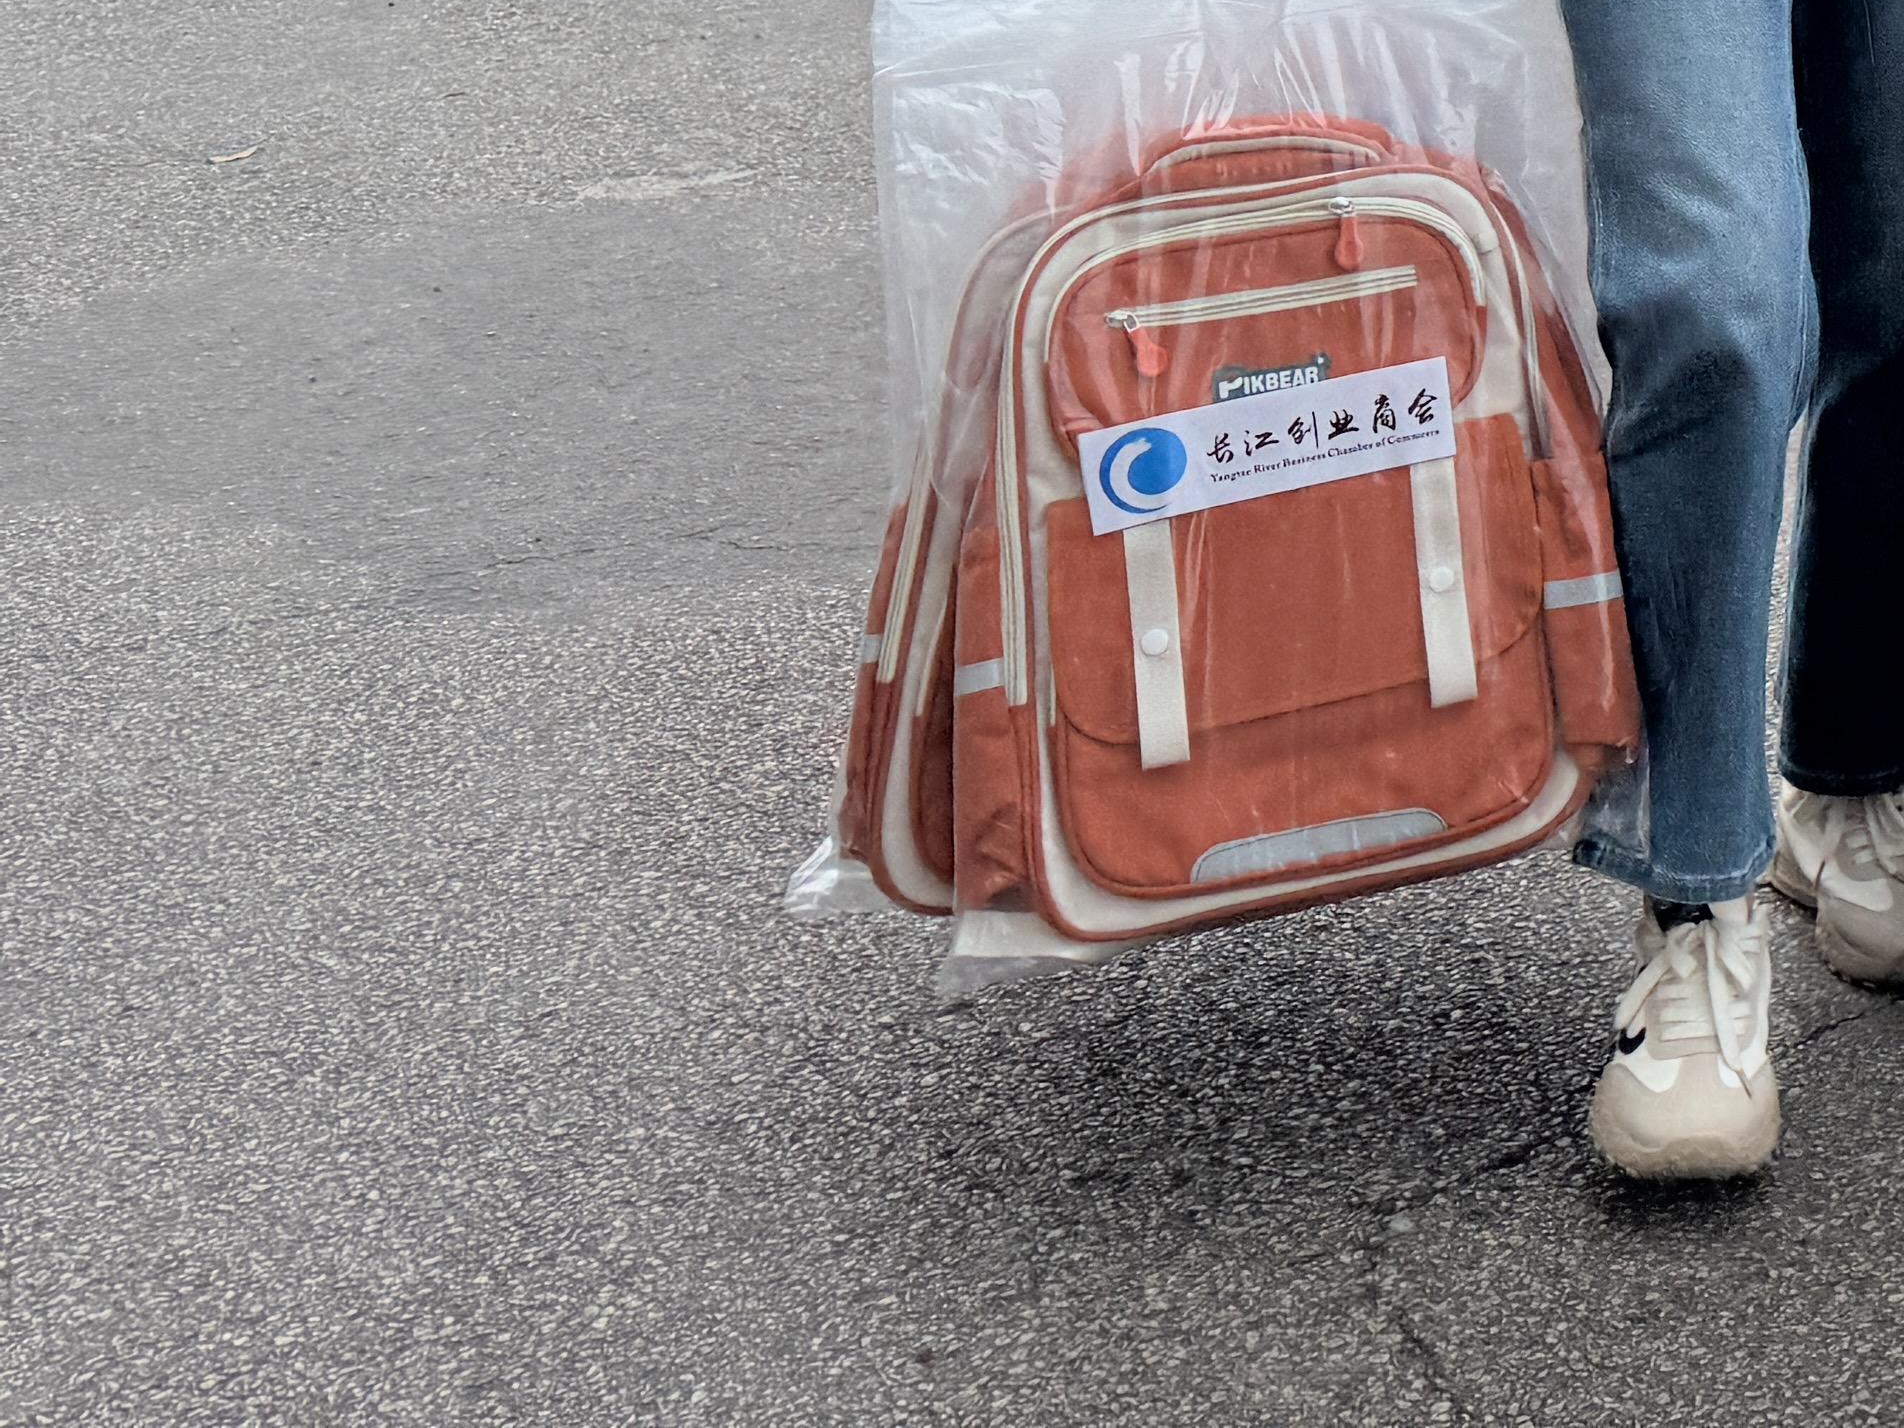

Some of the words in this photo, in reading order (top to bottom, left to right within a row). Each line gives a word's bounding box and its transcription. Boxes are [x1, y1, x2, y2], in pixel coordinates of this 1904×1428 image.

[1207, 388, 1438, 464] 长江创业商会
[1253, 460, 1281, 474] River
[1375, 437, 1387, 450] of
